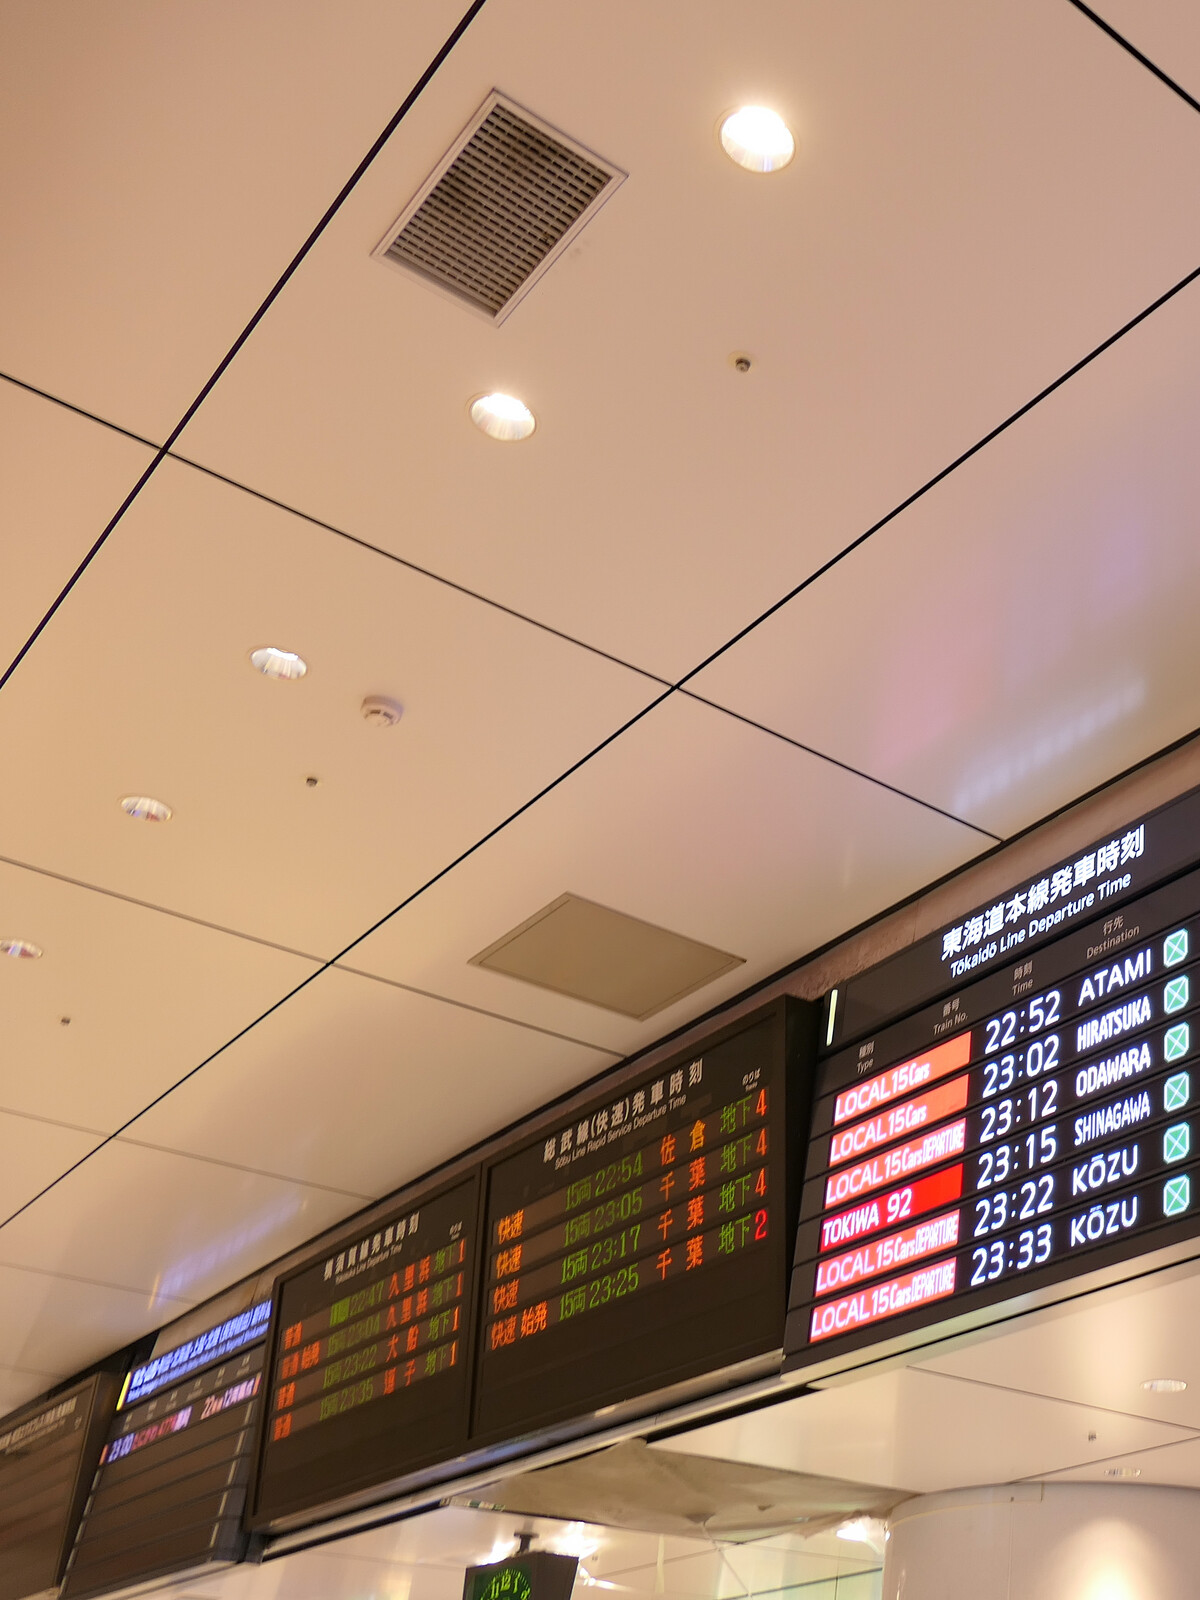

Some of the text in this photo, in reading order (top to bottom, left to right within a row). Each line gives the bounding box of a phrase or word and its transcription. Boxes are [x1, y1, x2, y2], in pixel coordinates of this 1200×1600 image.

[941, 824, 1146, 962] 東海道本線発車時刻
[950, 871, 1132, 979] Tōkaidō Line Departure Time
[1086, 923, 1141, 961] Destination
[1102, 914, 1124, 937] 行先
[933, 1010, 970, 1037] Train No.
[1012, 977, 1034, 997] Time
[1013, 961, 1033, 983] 時刻
[830, 1118, 887, 1162] LOCAL
[982, 1034, 1060, 1099] 23:02
[1076, 995, 1152, 1052] HIRATSUKA
[834, 1077, 892, 1122] LOCAL
[984, 990, 1061, 1055] 22:52
[1078, 949, 1152, 1007] ATAMI
[856, 1055, 875, 1076] Type
[669, 1094, 688, 1110] Time
[825, 1161, 884, 1205] LOCAL
[922, 1122, 965, 1163] DEPARTURE
[979, 1079, 1058, 1144] 23:12
[1075, 1042, 1152, 1097] ODAWARA
[496, 1244, 523, 1279] 快速
[593, 1187, 643, 1237] 23:05
[659, 1156, 706, 1201] 千葉
[498, 1210, 525, 1245] 快速
[594, 1151, 643, 1197] 22:54
[660, 1119, 706, 1166] 佐倉
[816, 1252, 875, 1292] LOCAL
[915, 1214, 959, 1253] DEPARTURE
[974, 1174, 1054, 1237] 23:22
[1072, 1144, 1138, 1196] KŌZU
[823, 1202, 880, 1247] TOKIWA
[887, 1188, 913, 1223] 92
[977, 1124, 1057, 1190] 23:15
[1074, 1091, 1151, 1147] SHINAGAWA
[493, 1278, 520, 1314] 快速
[591, 1224, 641, 1271] 23:17
[658, 1195, 704, 1240] 千葉
[589, 1263, 640, 1309] 23:25
[656, 1235, 703, 1280] 千葉
[811, 1295, 871, 1338] LOCAL
[911, 1262, 957, 1300] DEPARTURE
[970, 1223, 1052, 1287] 23:33
[1070, 1196, 1138, 1247] KŌZU
[500, 1574, 511, 1592] 12
